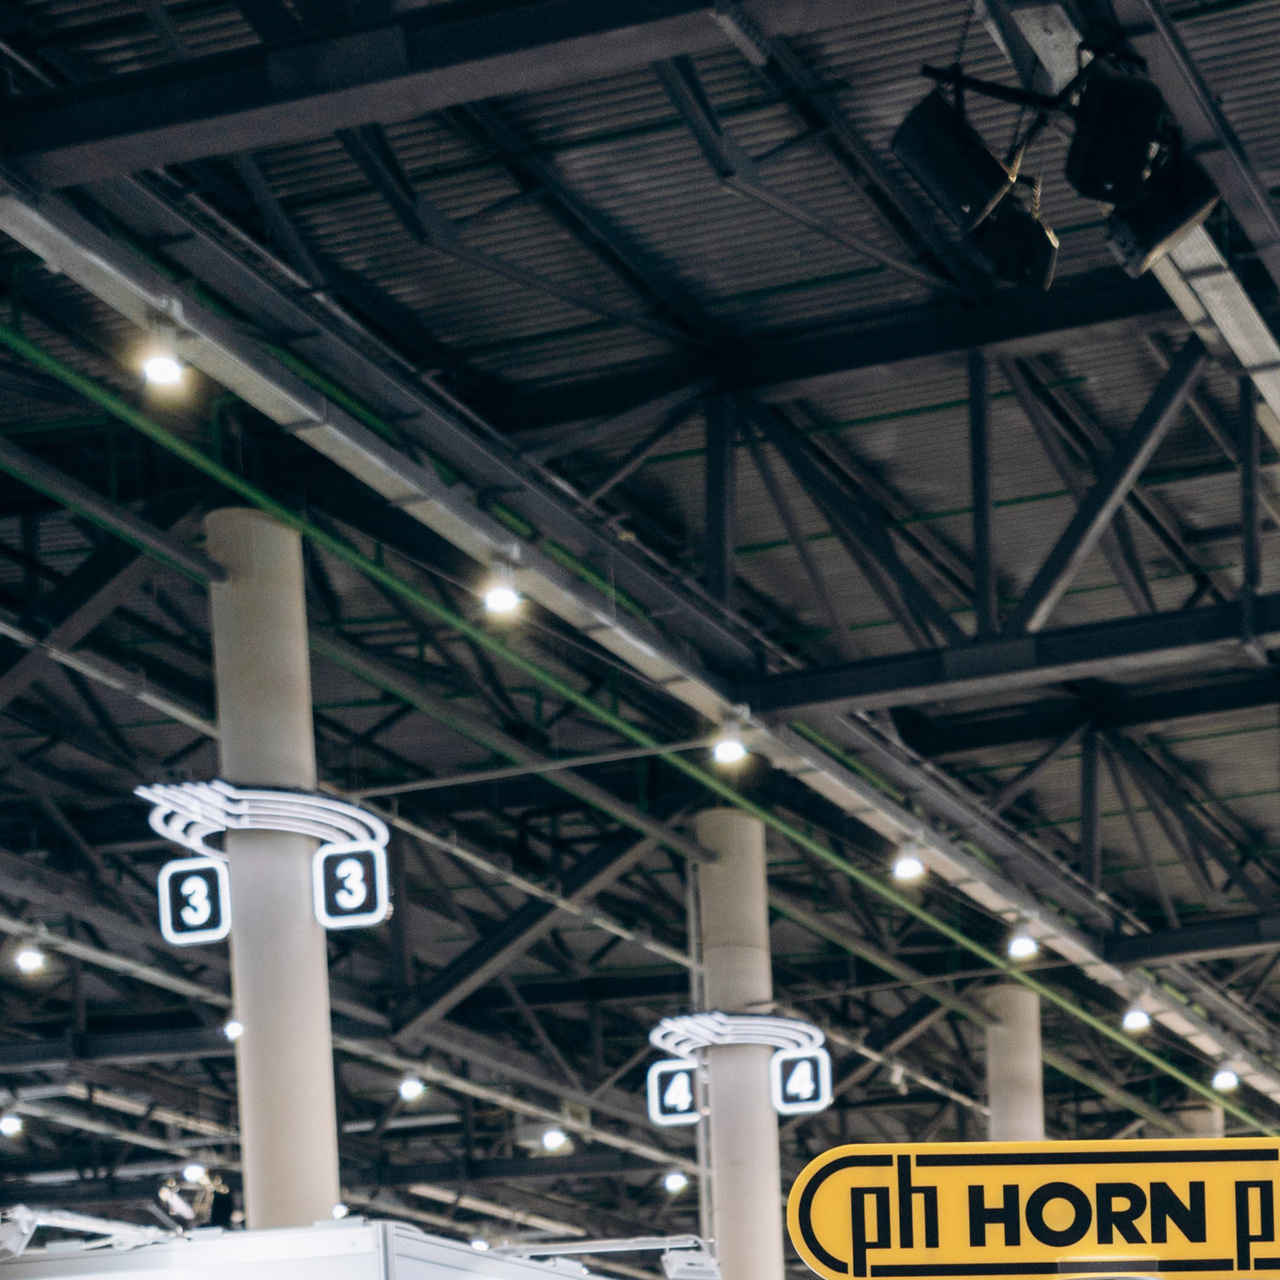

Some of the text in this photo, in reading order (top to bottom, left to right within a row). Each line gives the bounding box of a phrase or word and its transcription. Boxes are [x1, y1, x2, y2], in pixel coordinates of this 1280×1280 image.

[181, 876, 211, 926] 3
[336, 859, 366, 910] 3
[664, 1072, 691, 1111] 4
[786, 1063, 814, 1100] 4
[968, 1181, 1206, 1247] HORN
